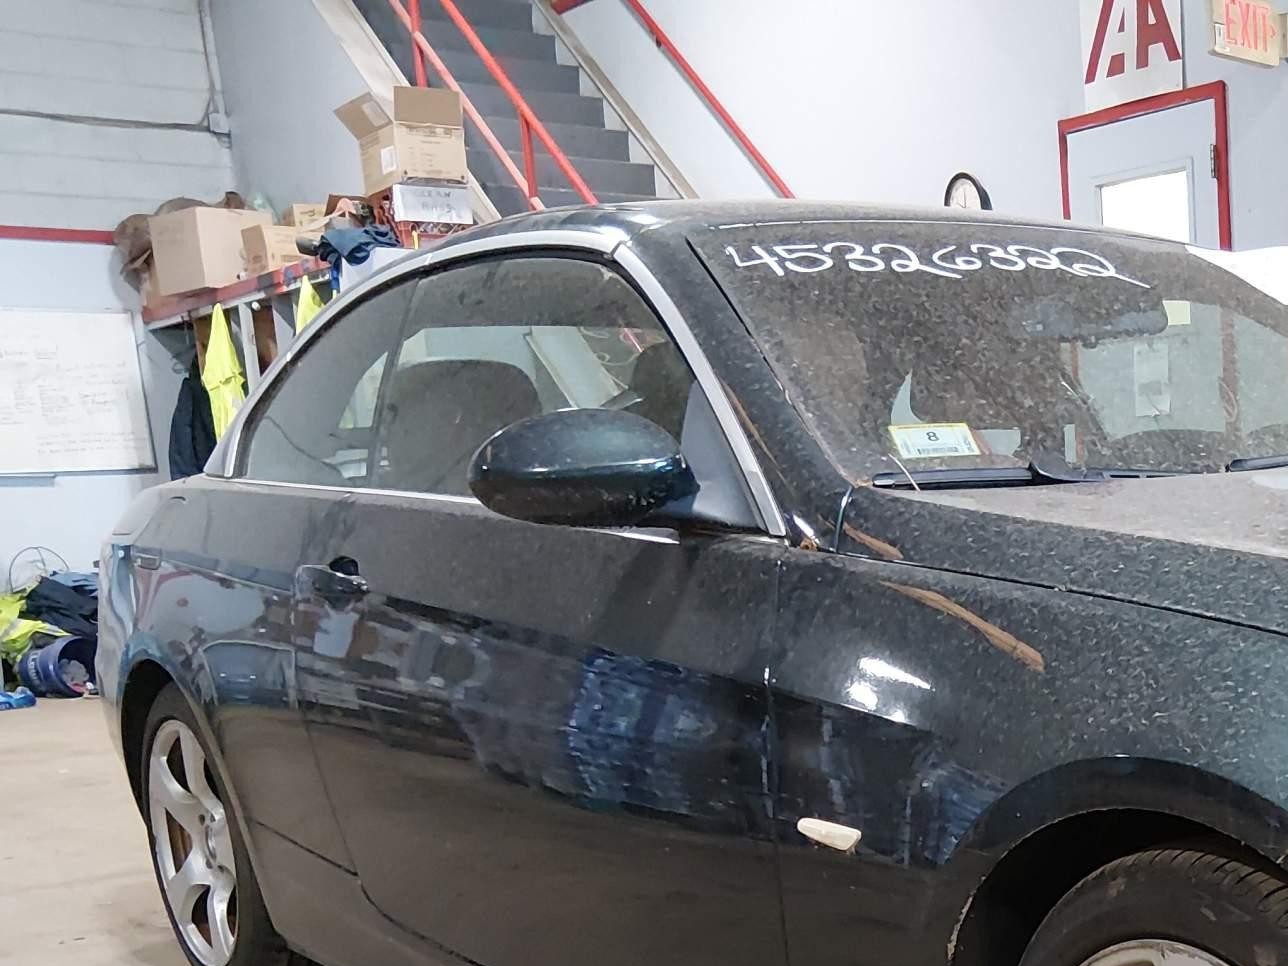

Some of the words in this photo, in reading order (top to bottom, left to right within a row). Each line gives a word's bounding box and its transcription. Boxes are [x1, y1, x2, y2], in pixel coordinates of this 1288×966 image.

[1223, 0, 1270, 53] EXIT
[724, 241, 1151, 289] 45326322
[926, 431, 940, 442] 8
